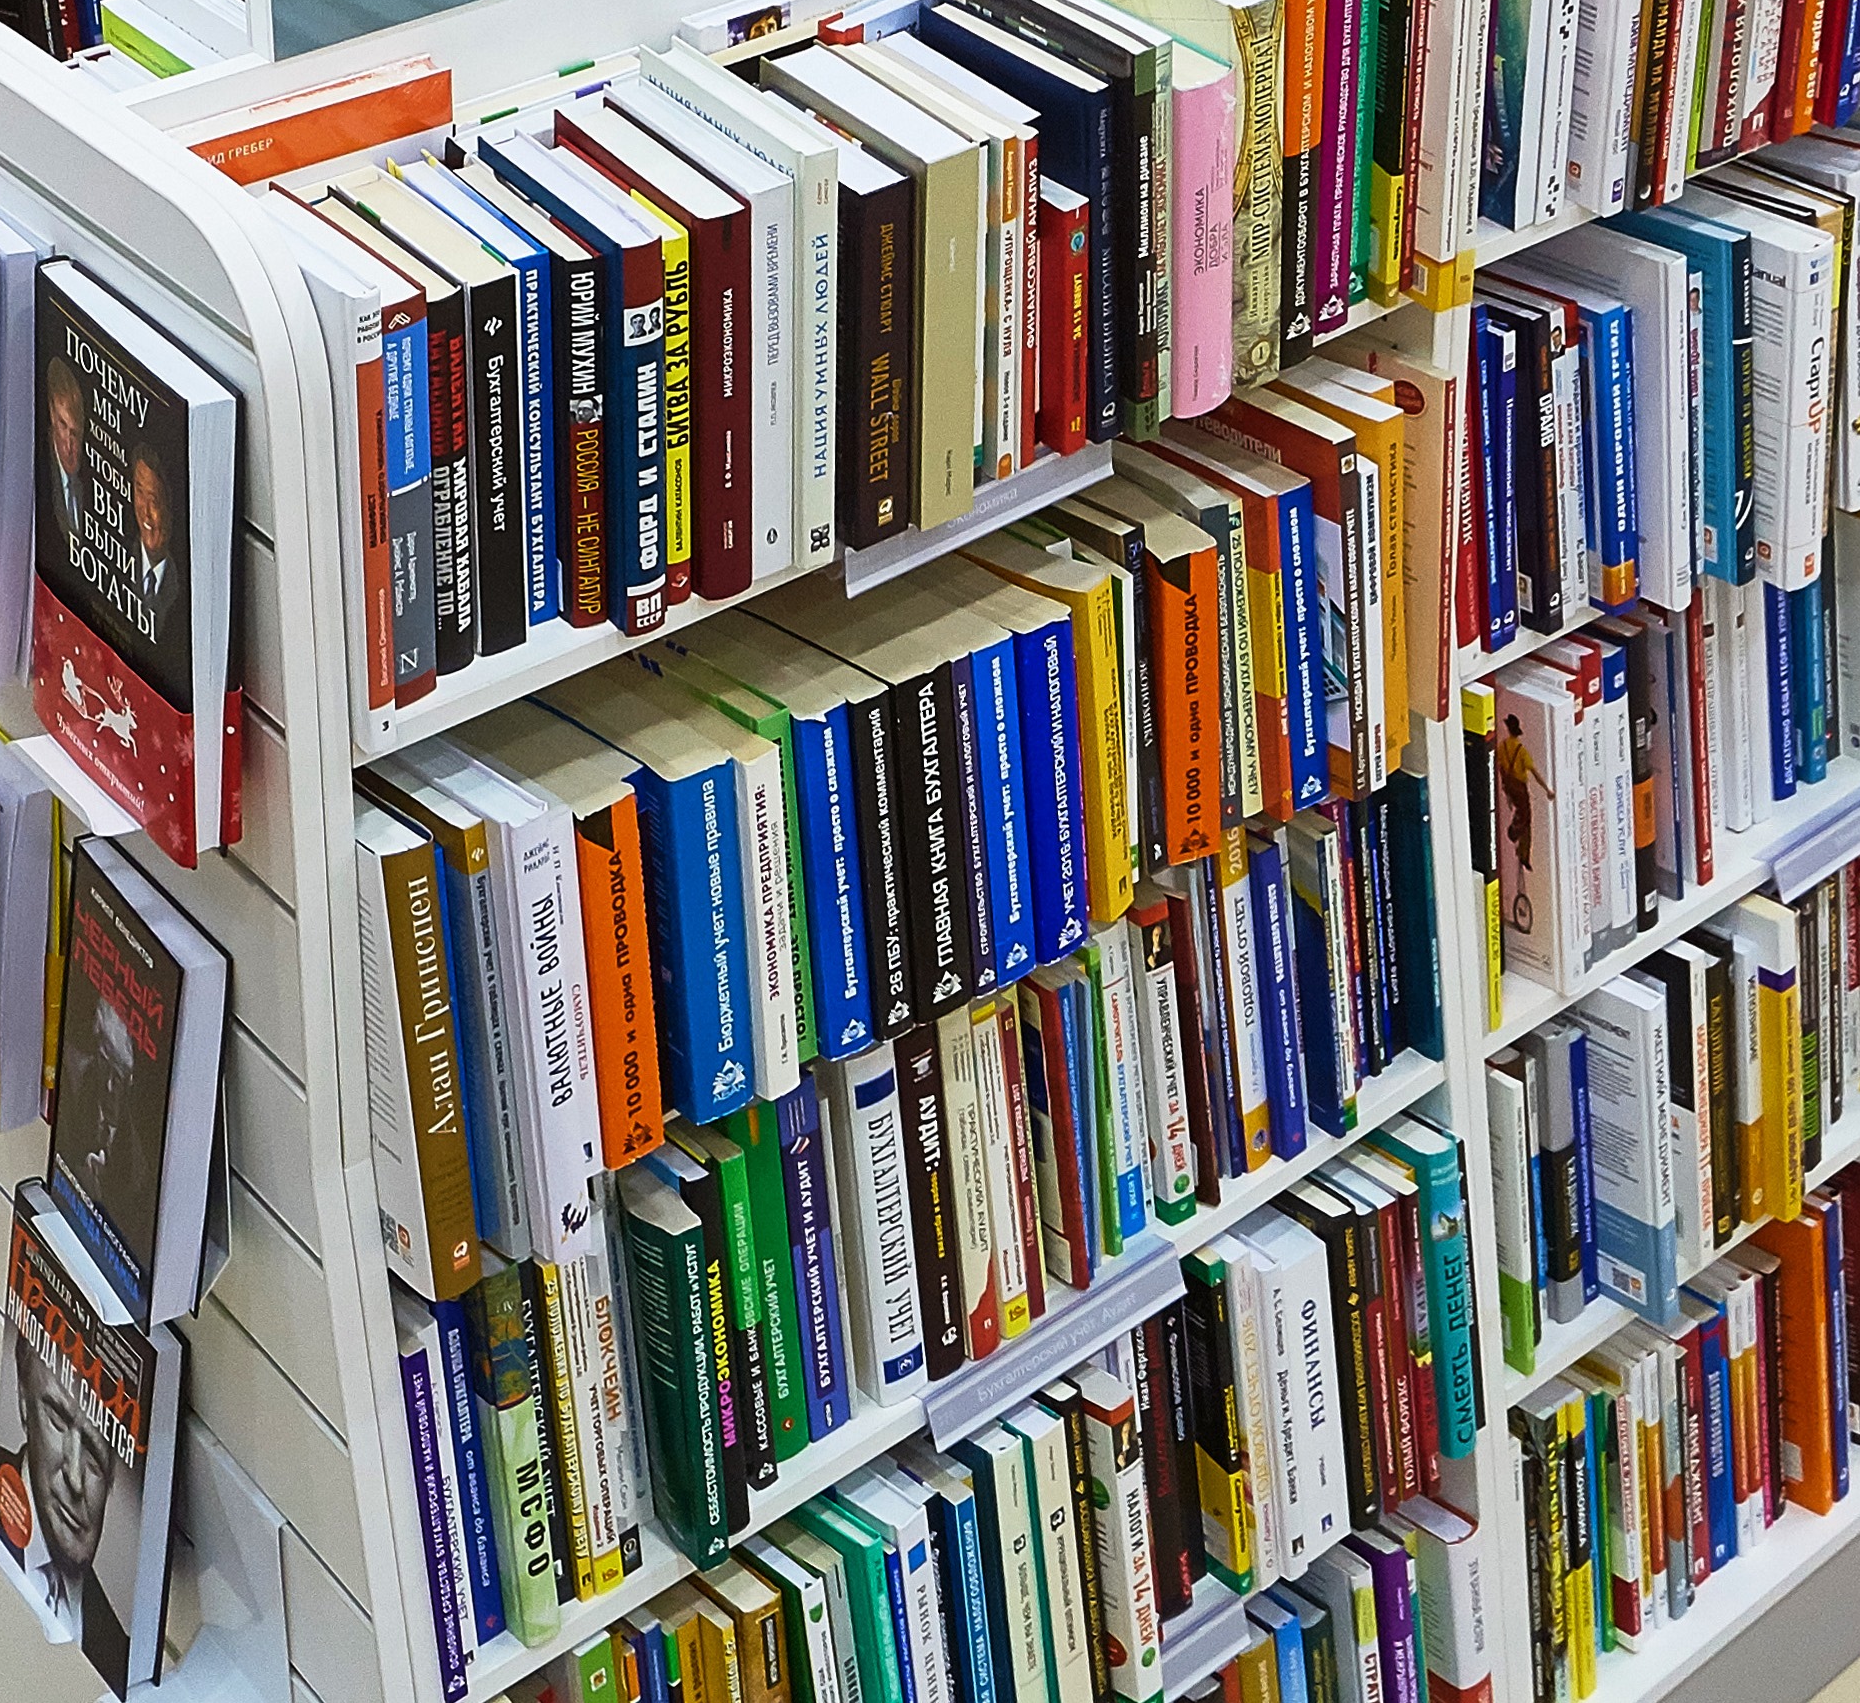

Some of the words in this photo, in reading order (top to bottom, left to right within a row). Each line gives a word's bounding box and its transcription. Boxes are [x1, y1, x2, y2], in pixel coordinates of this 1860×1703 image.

[1722, 13, 1747, 148] ПСИХОЛОГИЯ
[227, 137, 275, 163] ГРЕБЕР
[814, 233, 829, 314] ЛЮДЕЙ
[1194, 188, 1207, 276] ЭКОНОМИКА
[526, 266, 541, 395] ПРАКТИЧЕСКИЙ
[571, 269, 594, 326] ЮРИЙ
[669, 259, 691, 336] РУБЛЬ
[65, 325, 150, 429] ПОЧЕМУ
[572, 330, 596, 397] МУХИН
[669, 338, 690, 366] ЗА
[722, 287, 734, 397] МИКРОЭКОНОМИКА
[813, 320, 829, 399] УМНЫХ
[868, 353, 887, 408] WALL
[93, 388, 121, 435] МЫ
[487, 354, 506, 489] Бухгалтерский
[528, 398, 543, 510] КОНСУЛЬТАНТ
[636, 361, 656, 460] СТАЛИН
[668, 372, 690, 451] БИТВА
[813, 405, 828, 481] НАЦИЯ
[869, 413, 888, 485] STREET
[85, 441, 134, 502] ЧТОБЫ
[94, 478, 126, 535] ВЫ
[491, 492, 507, 534] учет
[636, 465, 657, 492] И
[83, 516, 137, 585] БЫЛИ
[531, 513, 545, 613] БУХГАЛТЕРА
[637, 497, 657, 571] ФОРД
[68, 528, 158, 645] БОГАТЫ
[921, 682, 944, 804] БУХГАЛТЕРА
[928, 807, 948, 873] КНИГА
[409, 874, 446, 1038] Гринспен
[539, 892, 561, 972] ВОЙНЫ
[932, 877, 953, 965] ГЛАВНАЯ
[73, 936, 158, 1061] ЛЕБЕДЬ
[572, 984, 588, 1079] САМОУЧИТЕЛЬ
[551, 980, 573, 1108] ВАЛЮТНЫЕ
[428, 1045, 456, 1137] Алан
[918, 1094, 938, 1172] АУДИТ:
[1446, 1247, 1466, 1333] ДЕНЕГ
[8, 1285, 56, 1375] НИКОГДА
[60, 1358, 76, 1395] НЕ
[79, 1381, 136, 1470] СДАЕТСЯ
[596, 1295, 622, 1423] БЛОКЧЕЙН
[707, 1260, 735, 1448] МИКРОЭКОНОМИКА
[1300, 1299, 1326, 1429] ФИНАНСЫ
[1449, 1339, 1470, 1445] СМЕРТЬ
[517, 1459, 548, 1578] МСФО
